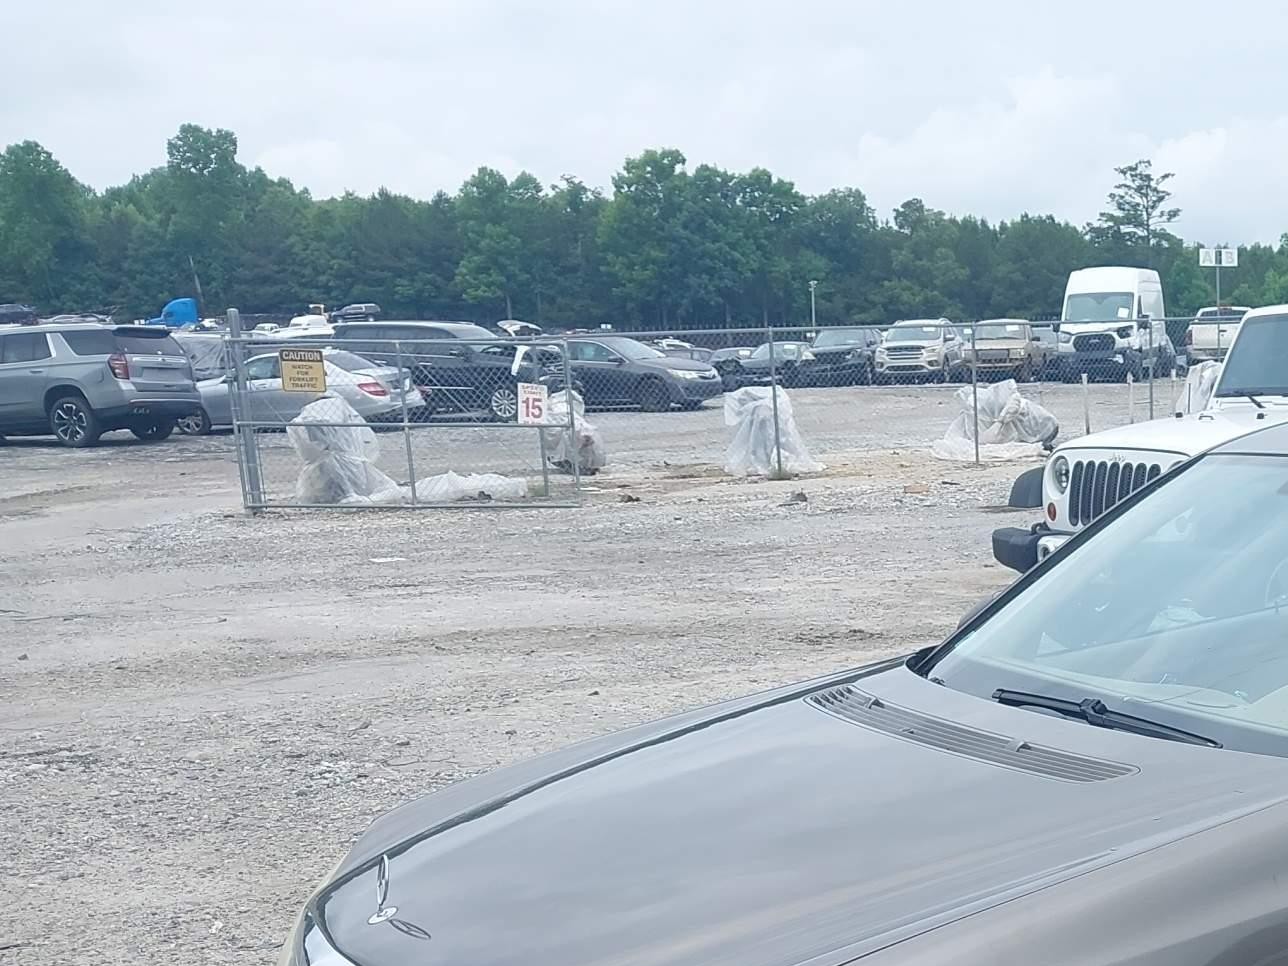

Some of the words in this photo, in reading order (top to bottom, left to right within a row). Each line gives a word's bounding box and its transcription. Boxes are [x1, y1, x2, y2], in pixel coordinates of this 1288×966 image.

[1202, 251, 1213, 264] A
[1225, 251, 1234, 264] B
[282, 351, 321, 360] CAUTION
[521, 397, 543, 419] 15
